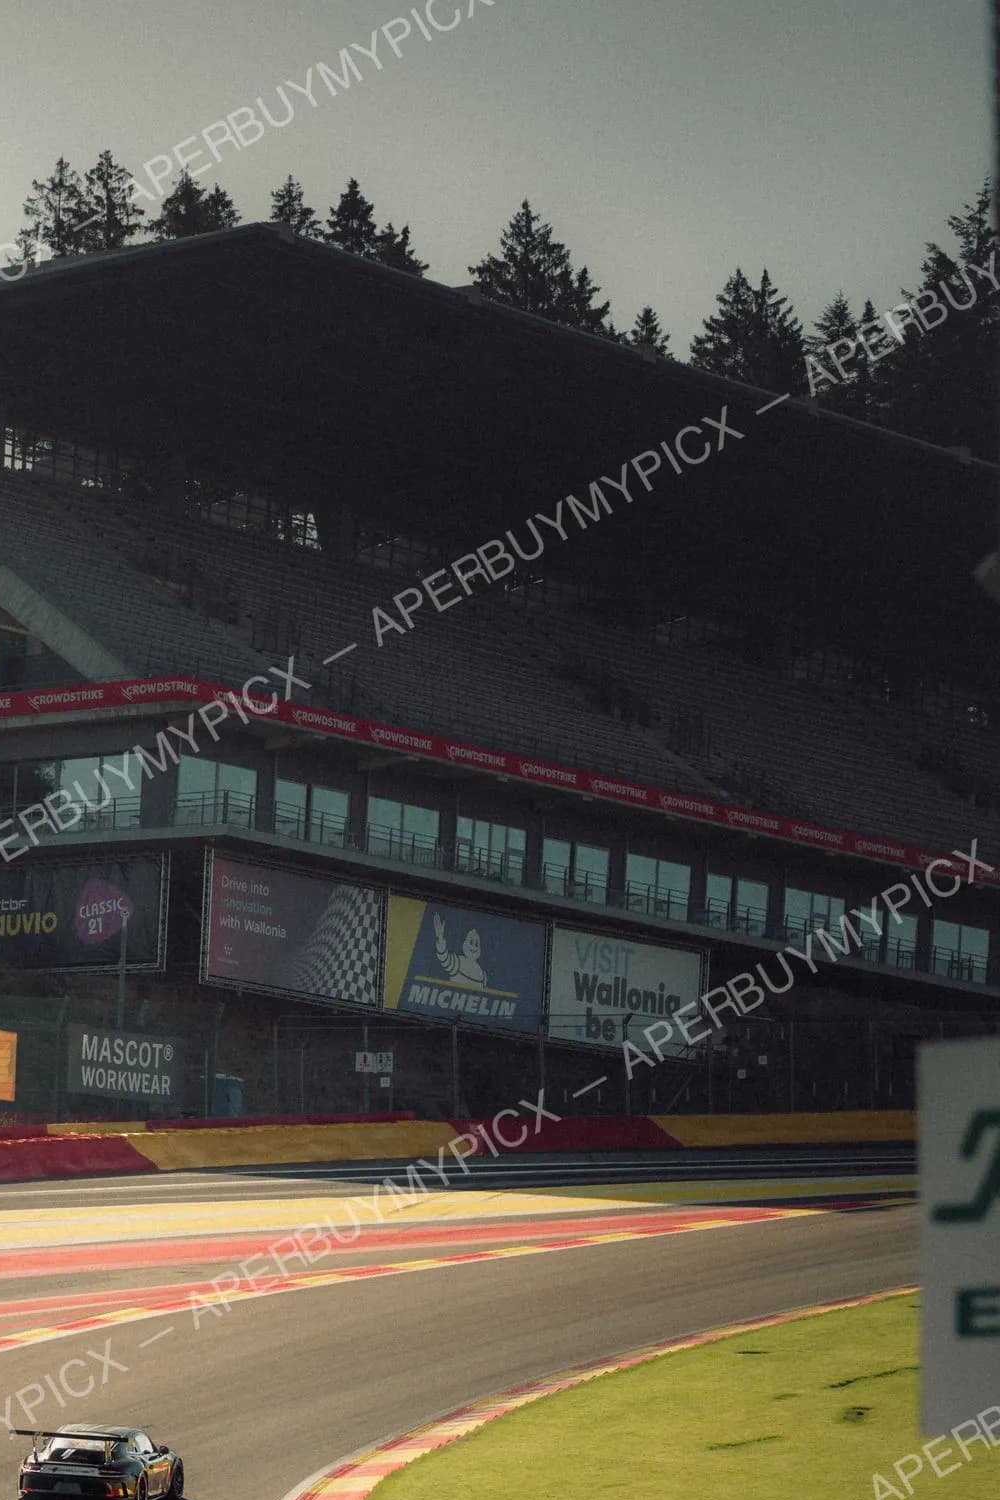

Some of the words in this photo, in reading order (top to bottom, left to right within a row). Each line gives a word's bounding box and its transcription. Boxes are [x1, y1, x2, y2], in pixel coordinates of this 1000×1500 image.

[34, 689, 104, 706] CROWDSTRIKE
[126, 680, 199, 696] CROWDSTRIKE
[296, 709, 357, 733] CROWDSTRIKE
[374, 728, 433, 751] CROWDSTRIKE
[449, 746, 506, 767] CROWDSTRIKE
[80, 897, 124, 919] CLASSIC
[88, 919, 103, 935] 21
[244, 919, 287, 939] Wallonia
[574, 937, 634, 977] VISIT
[407, 983, 517, 1020] MICHELIN
[573, 971, 681, 1018] Wallonia
[81, 1065, 171, 1097] WORKWEAR
